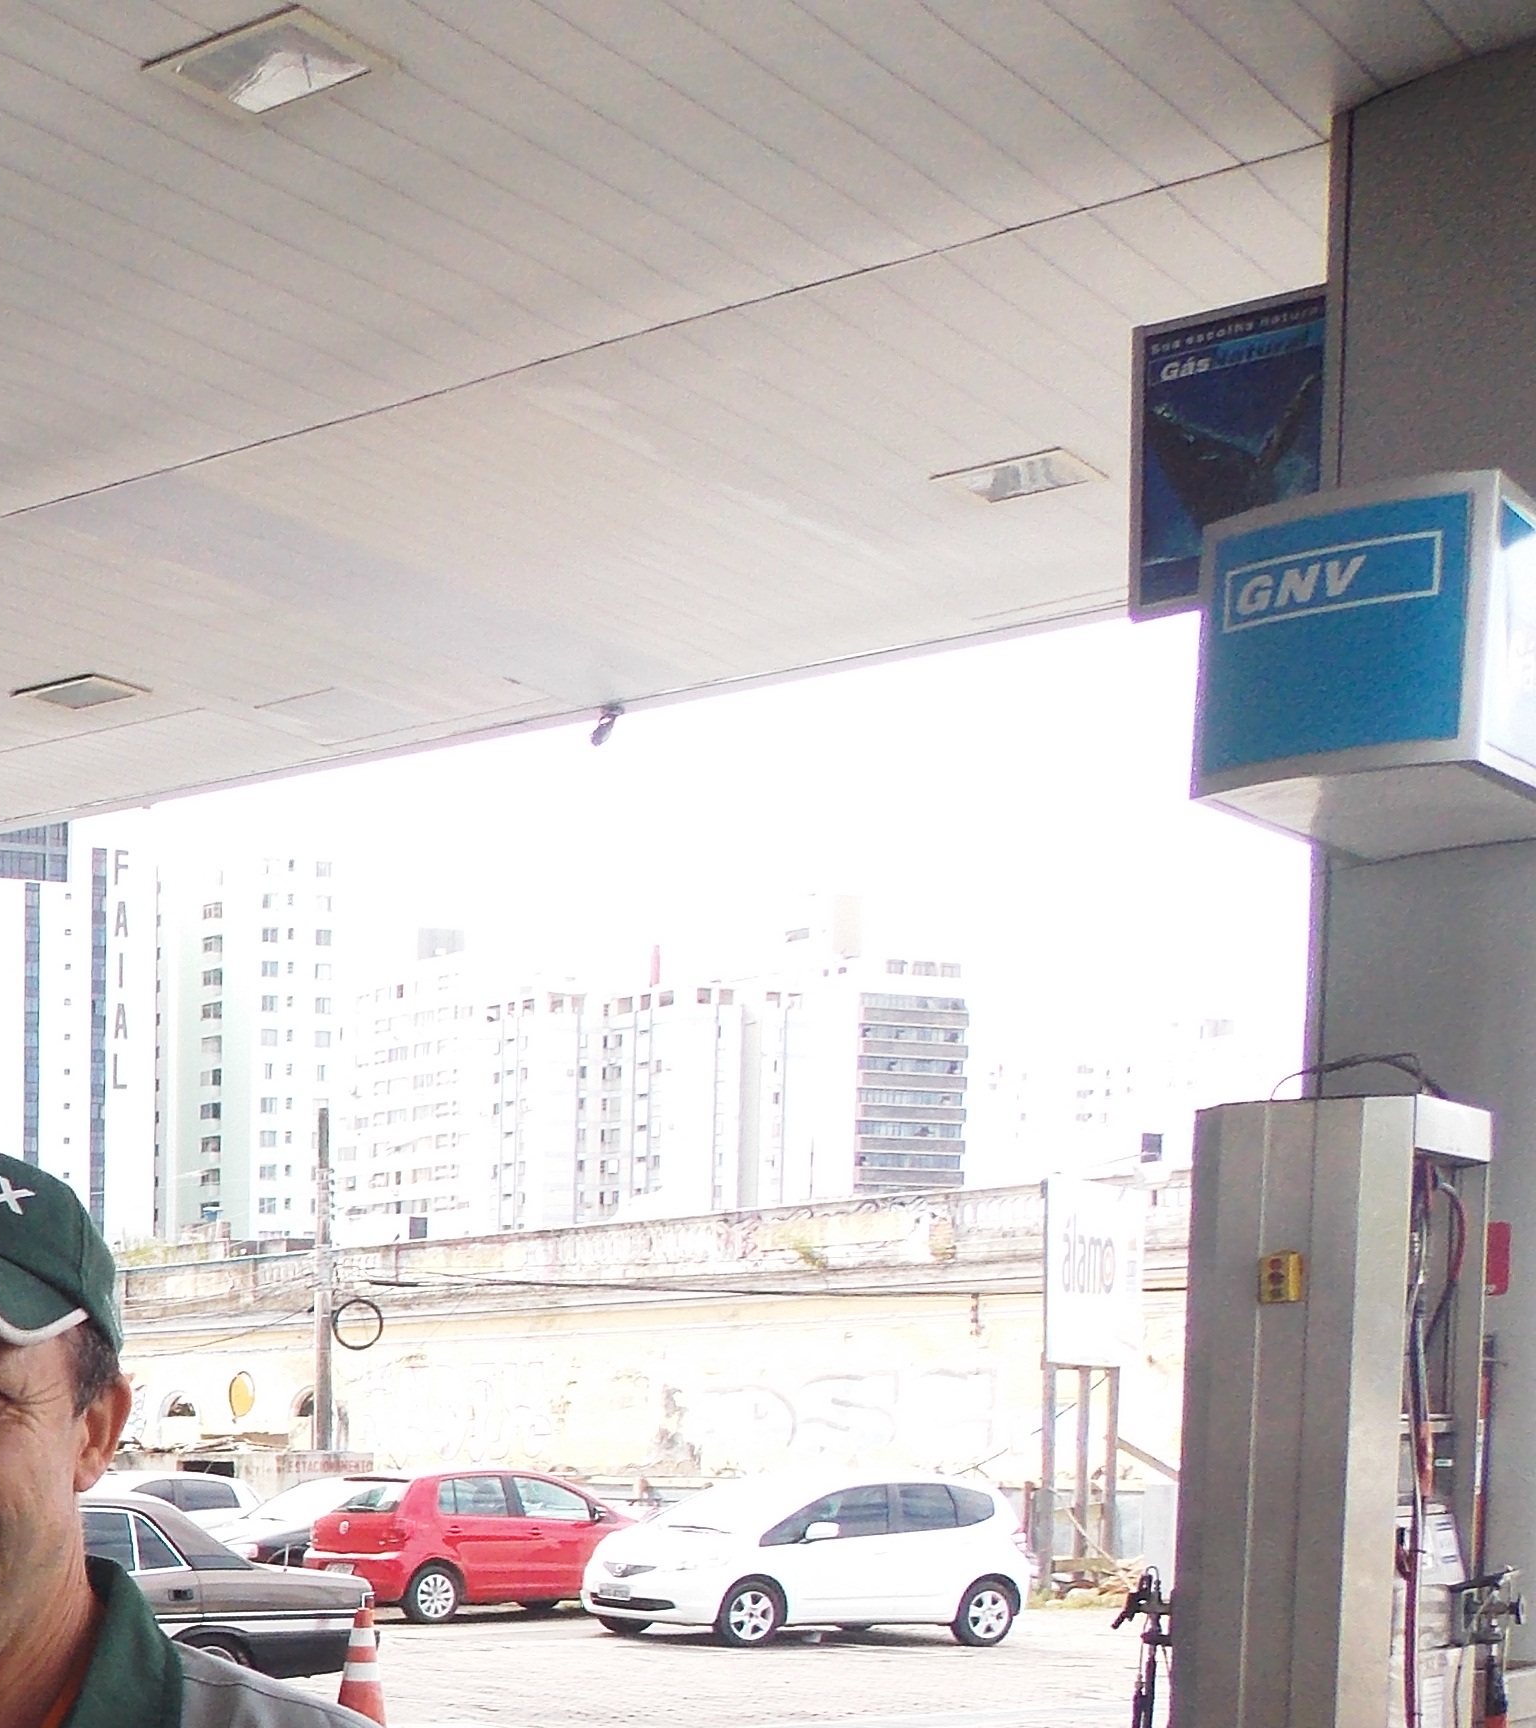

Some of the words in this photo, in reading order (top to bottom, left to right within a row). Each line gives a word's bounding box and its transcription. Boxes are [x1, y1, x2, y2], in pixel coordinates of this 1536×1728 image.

[1160, 356, 1212, 383] Gás
[1234, 554, 1368, 617] GNV
[112, 849, 130, 1090] FAIAL
